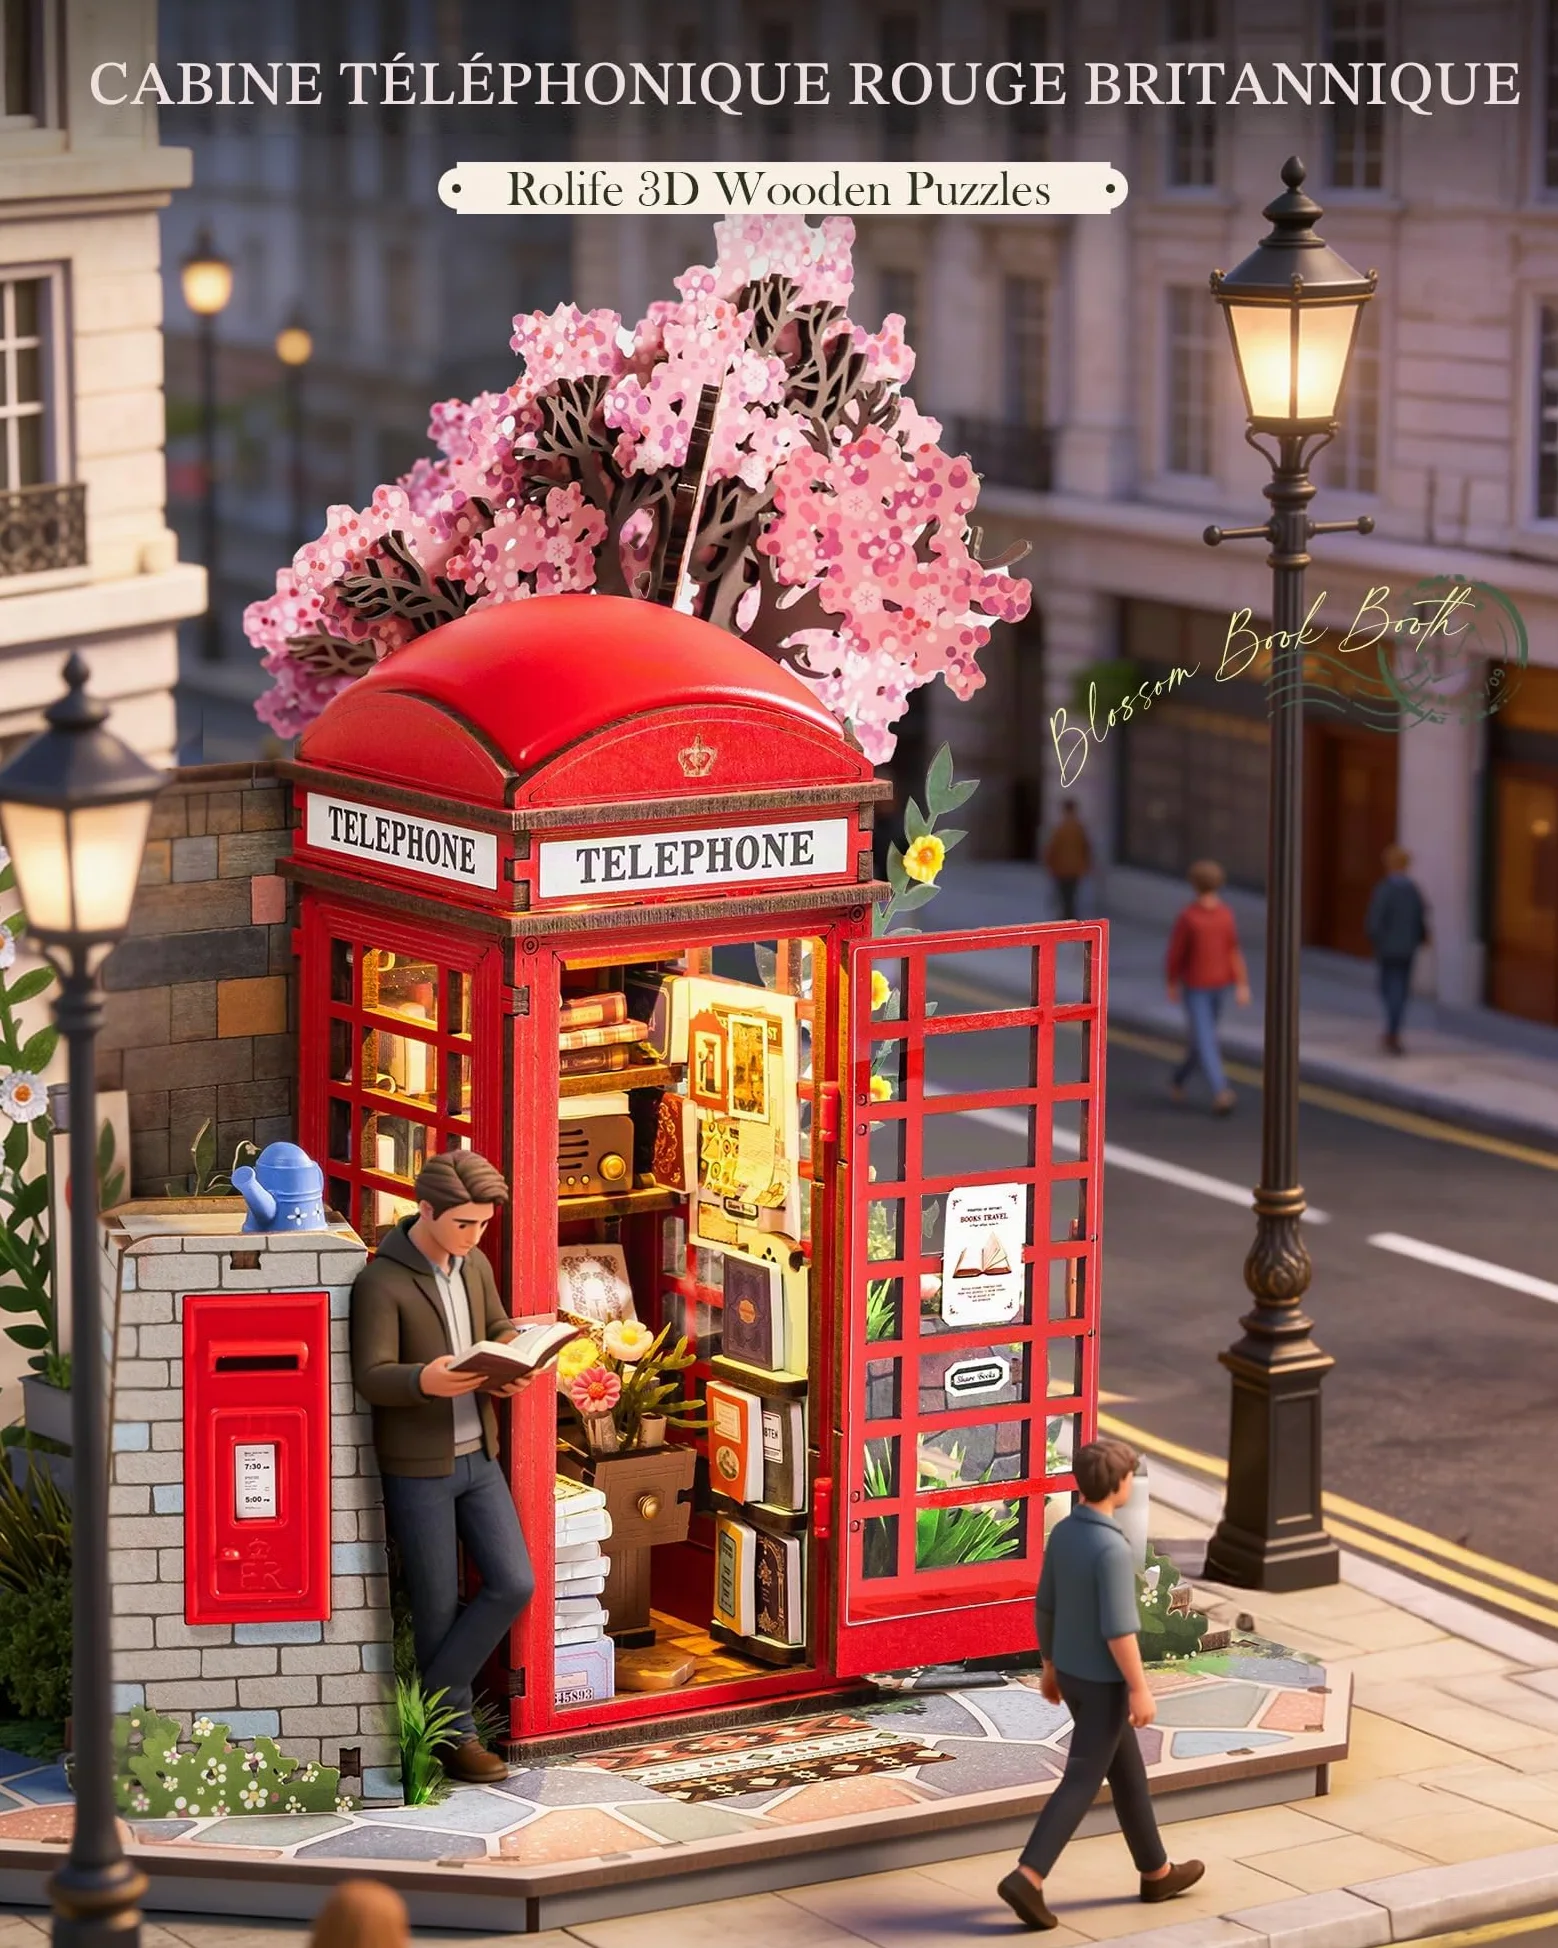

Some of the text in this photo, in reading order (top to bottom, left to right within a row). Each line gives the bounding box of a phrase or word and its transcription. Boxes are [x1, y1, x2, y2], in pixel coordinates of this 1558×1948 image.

[328, 805, 476, 876] TELEPHONE
[576, 829, 815, 885] TELEPHONE
[960, 1212, 1008, 1223] BOOKS TRAVEL
